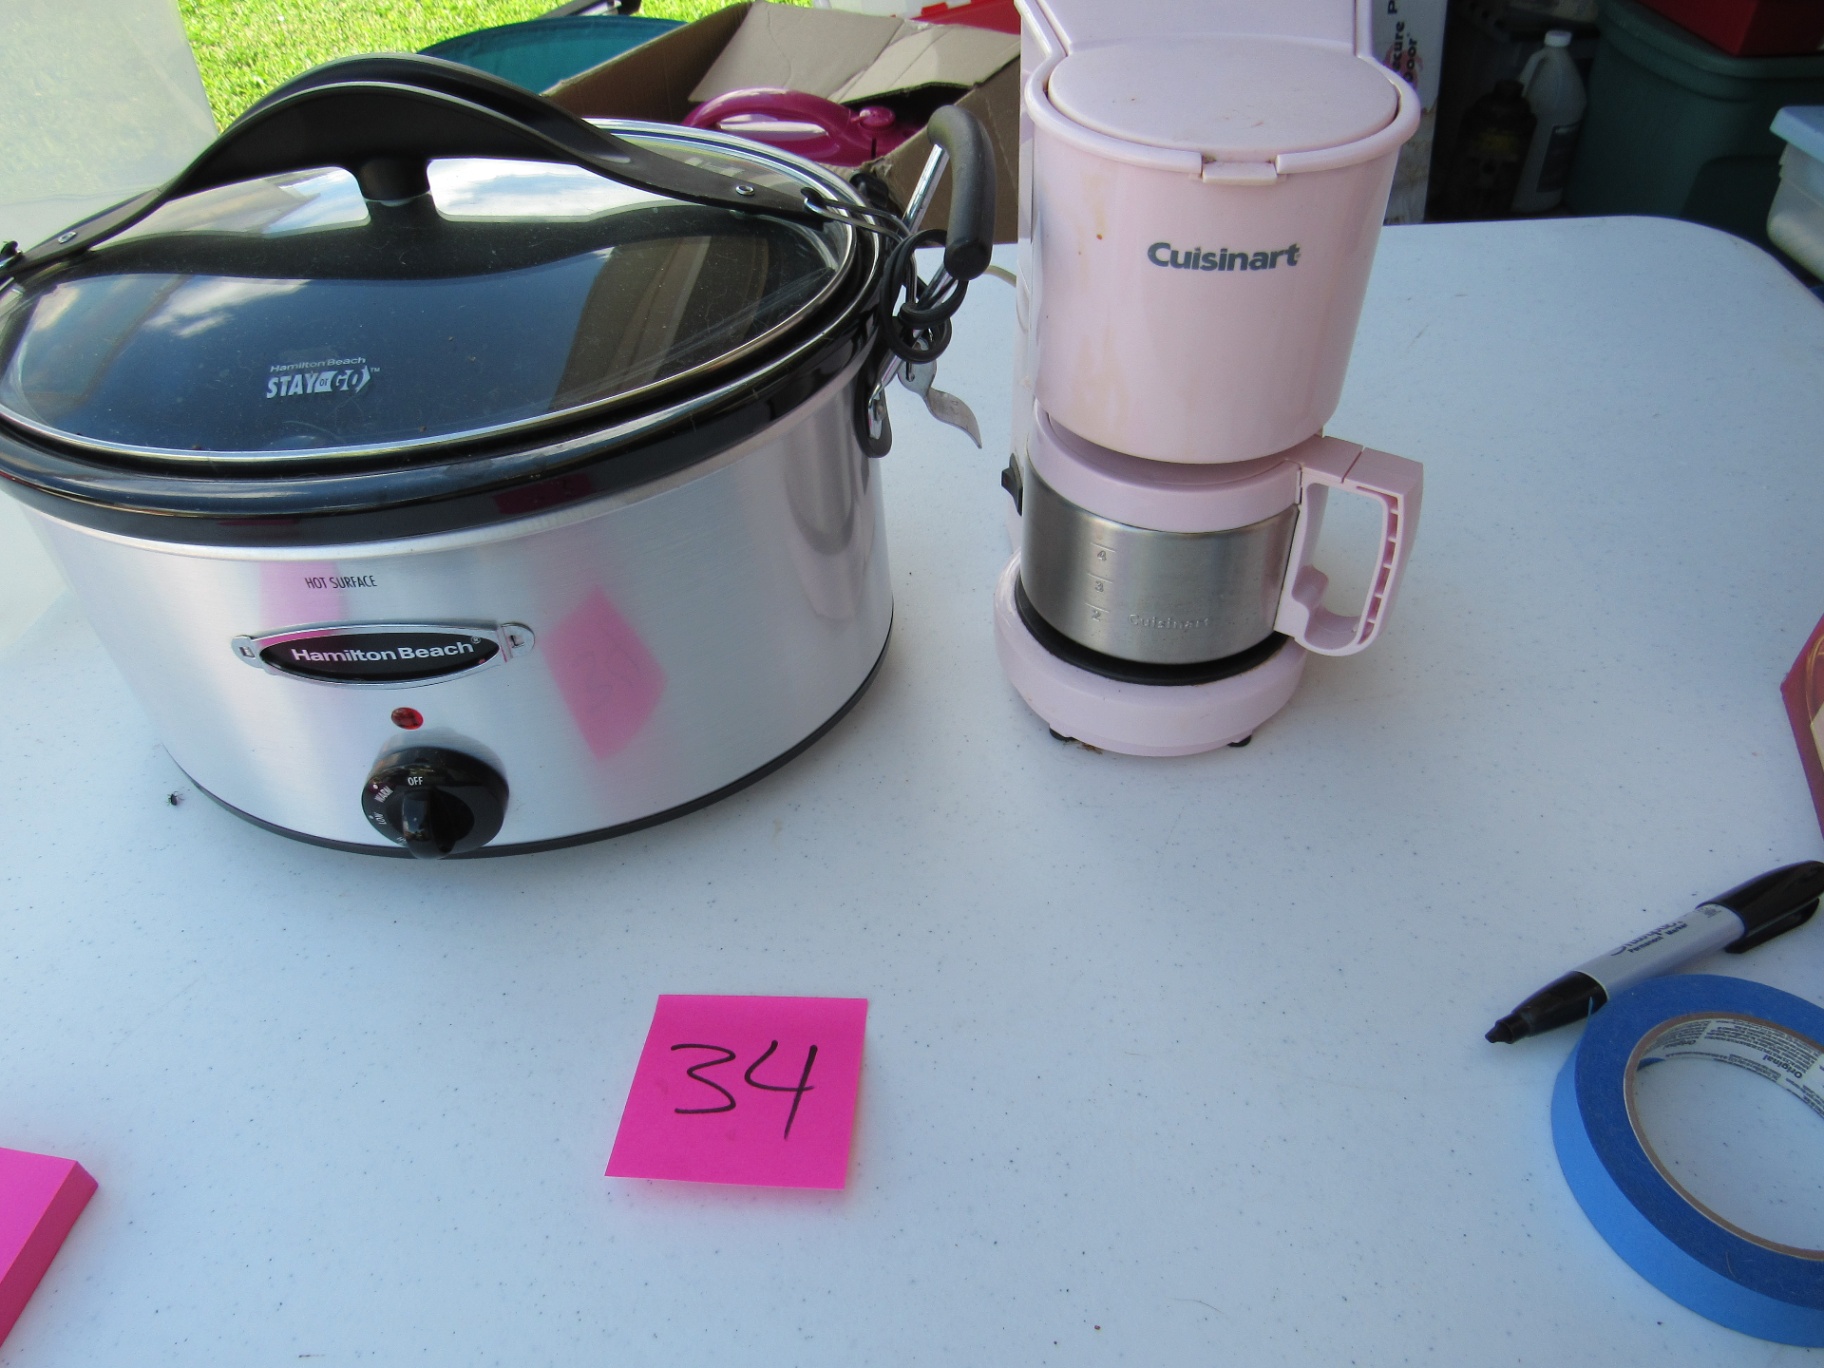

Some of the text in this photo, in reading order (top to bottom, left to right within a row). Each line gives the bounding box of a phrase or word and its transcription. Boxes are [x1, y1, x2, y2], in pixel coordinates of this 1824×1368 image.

[1147, 241, 1300, 272] Cuisinart
[266, 371, 320, 399] STAY
[1096, 550, 1107, 562] 4
[304, 574, 378, 590] HOT SURFACE
[290, 640, 475, 662] Hamilton Beach
[407, 776, 424, 786] OFF
[1762, 1053, 1803, 1079] Original
[671, 1039, 818, 1141] 34
